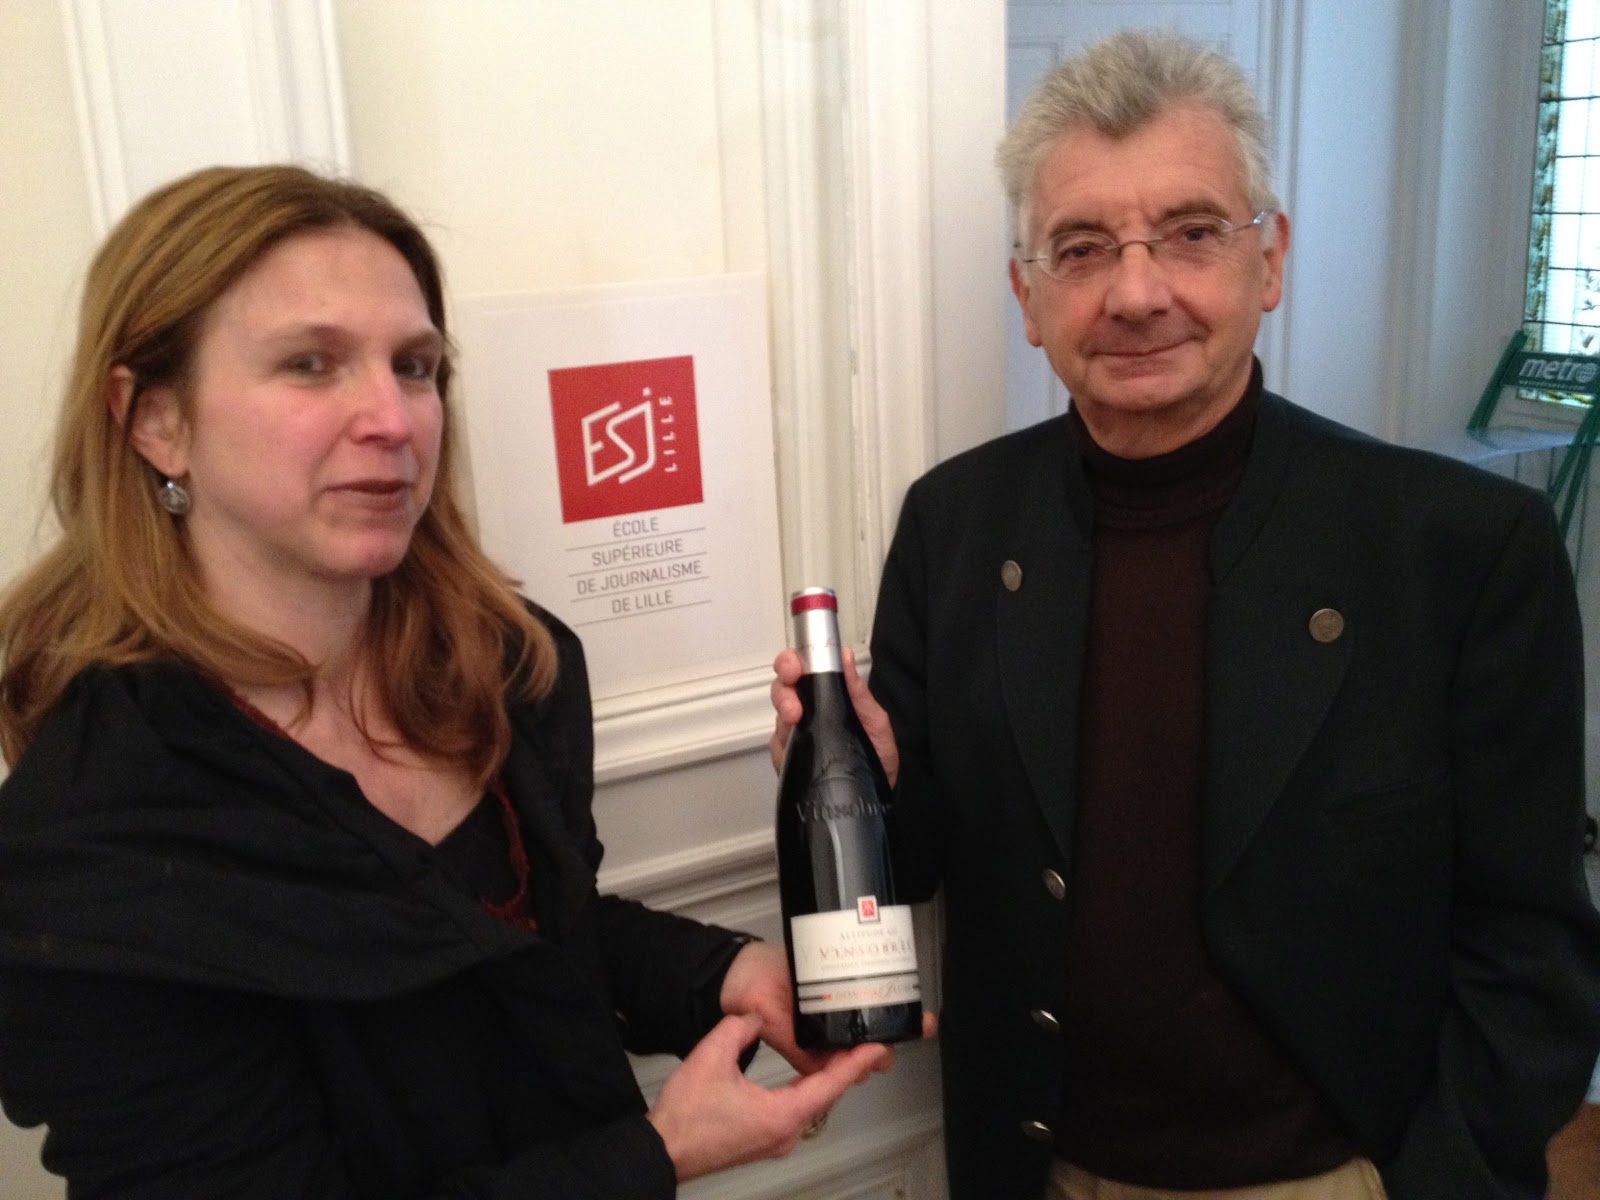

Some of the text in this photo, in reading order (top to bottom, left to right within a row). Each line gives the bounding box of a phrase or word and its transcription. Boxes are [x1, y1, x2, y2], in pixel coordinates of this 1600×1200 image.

[1519, 358, 1597, 383] metro
[658, 395, 678, 473] LILLE
[612, 516, 660, 538] ÉCOLE
[591, 537, 684, 567] SUPÉRIEURE
[576, 560, 703, 595] DE JOURNALISME
[611, 589, 673, 614] DE LILLE
